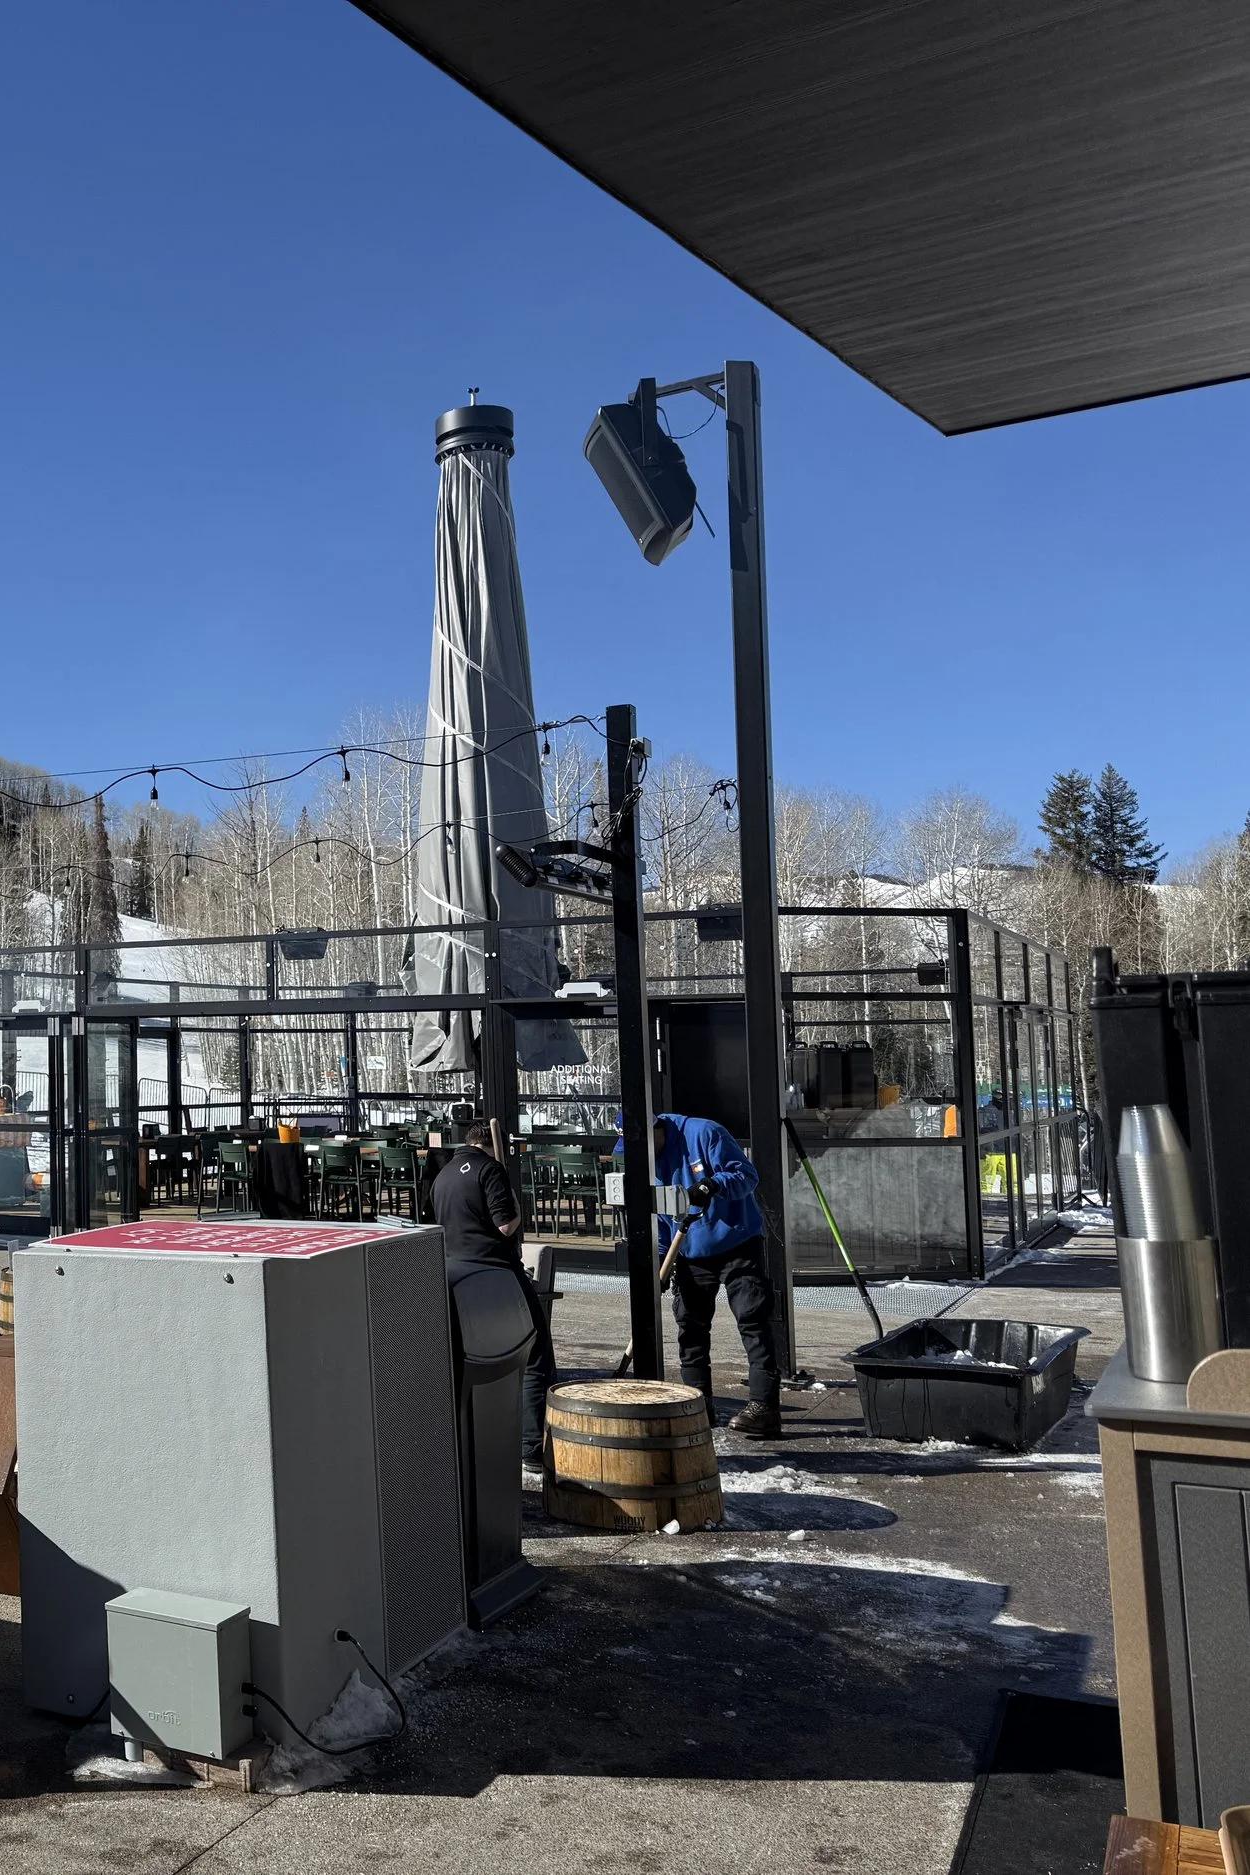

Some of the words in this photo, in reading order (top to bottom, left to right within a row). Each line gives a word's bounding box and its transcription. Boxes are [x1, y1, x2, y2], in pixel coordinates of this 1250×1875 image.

[551, 1065, 612, 1074] ADDITIONAL
[560, 1076, 602, 1084] SEATING
[614, 1515, 646, 1526] WOODY
[147, 1710, 181, 1725] orbit
